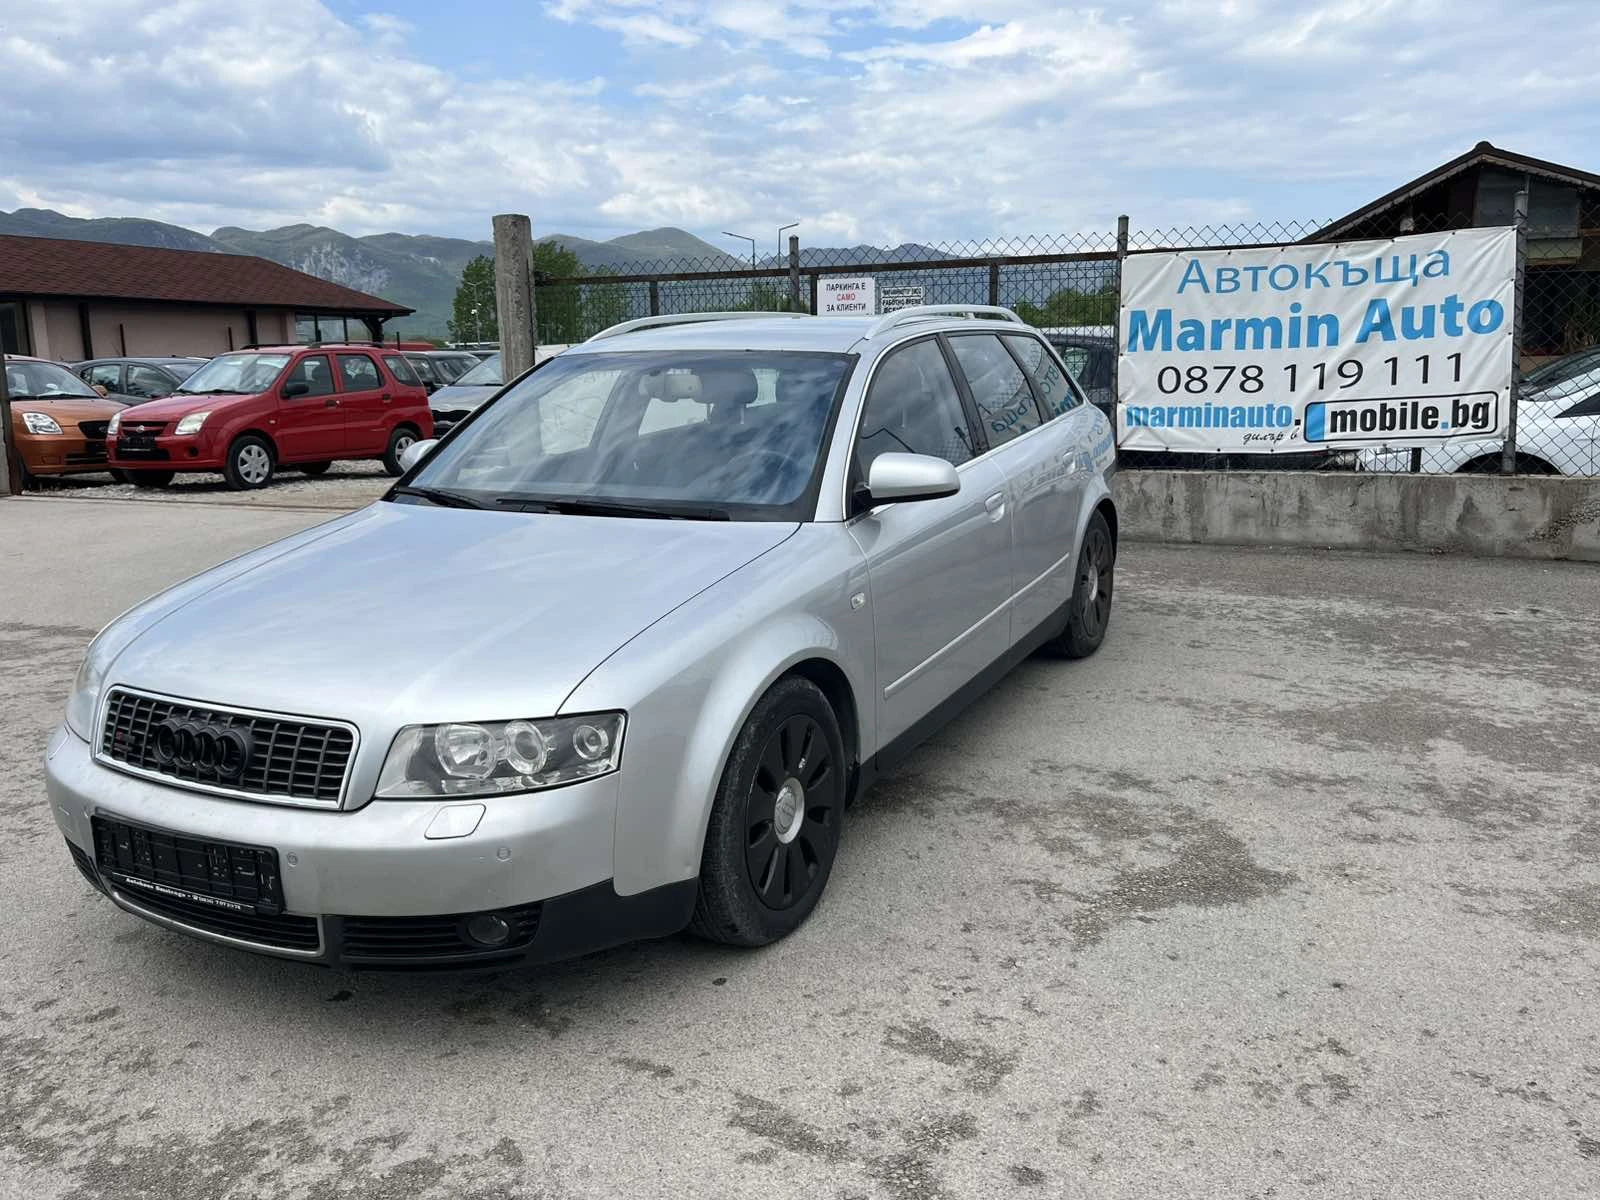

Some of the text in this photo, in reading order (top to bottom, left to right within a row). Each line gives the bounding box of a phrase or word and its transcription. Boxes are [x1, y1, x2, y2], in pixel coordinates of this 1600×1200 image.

[1177, 249, 1450, 294] Автокъща
[826, 282, 866, 291] ПАРКИНГА Е
[836, 293, 856, 301] САМО
[826, 303, 866, 312] ЗА КЛИЕНТИ
[1128, 294, 1504, 353] Marmin Auto
[1157, 352, 1463, 394] 0878 119 111
[1330, 399, 1490, 433] mobile.bg
[1243, 432, 1285, 445] дилър
